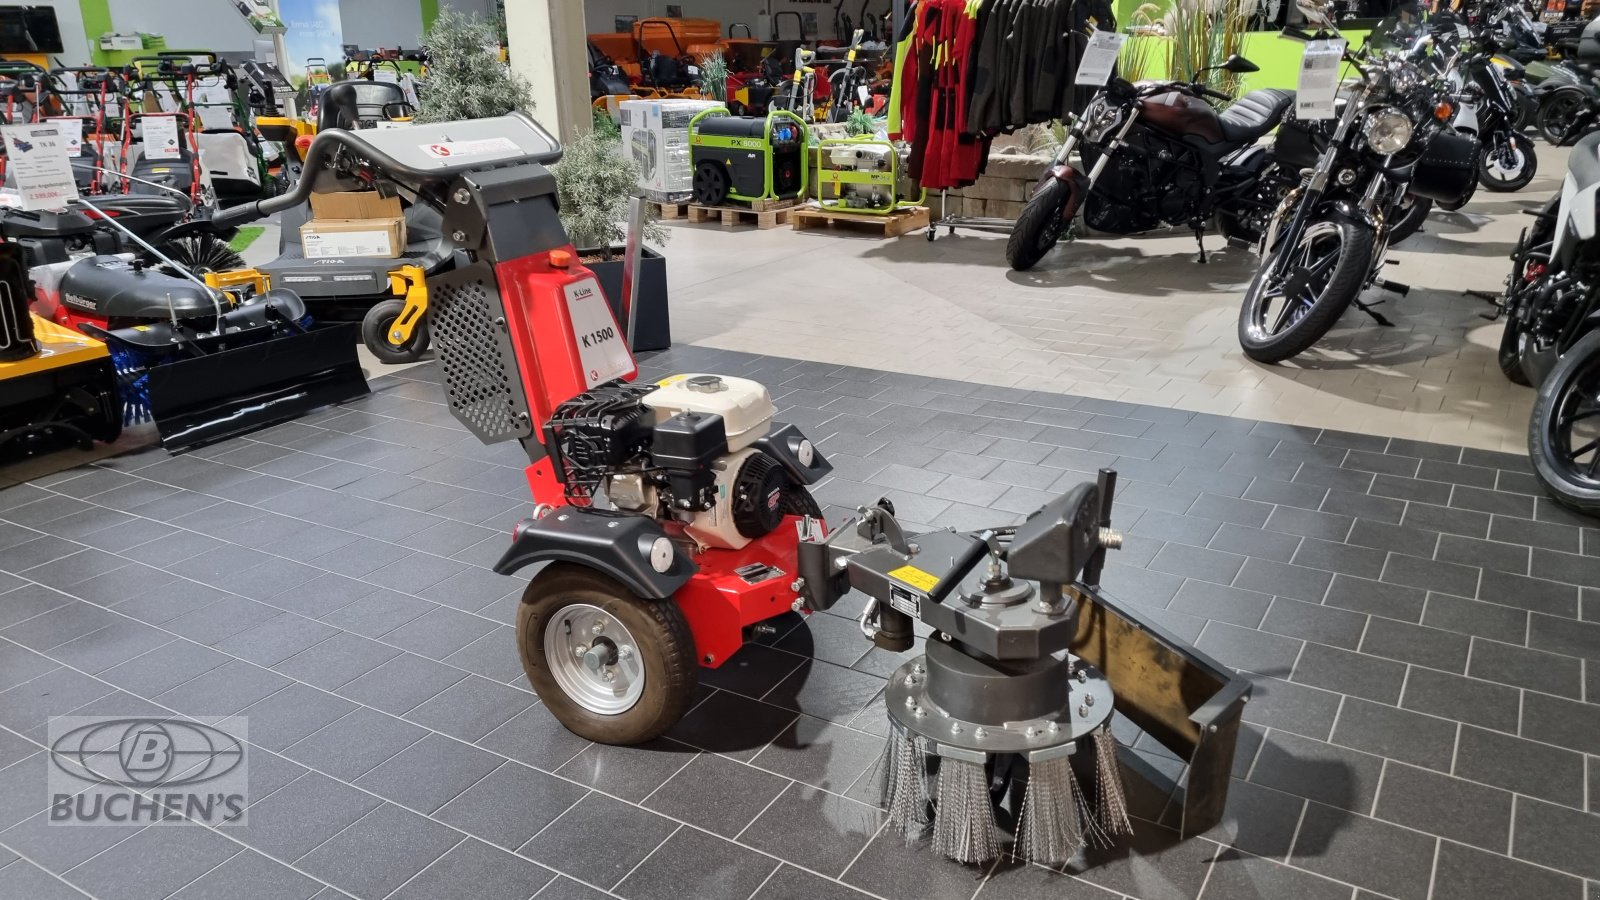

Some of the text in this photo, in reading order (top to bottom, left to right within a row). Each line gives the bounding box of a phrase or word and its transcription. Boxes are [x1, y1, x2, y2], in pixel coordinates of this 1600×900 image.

[573, 287, 592, 298] K-Line
[581, 326, 614, 348] K 1500
